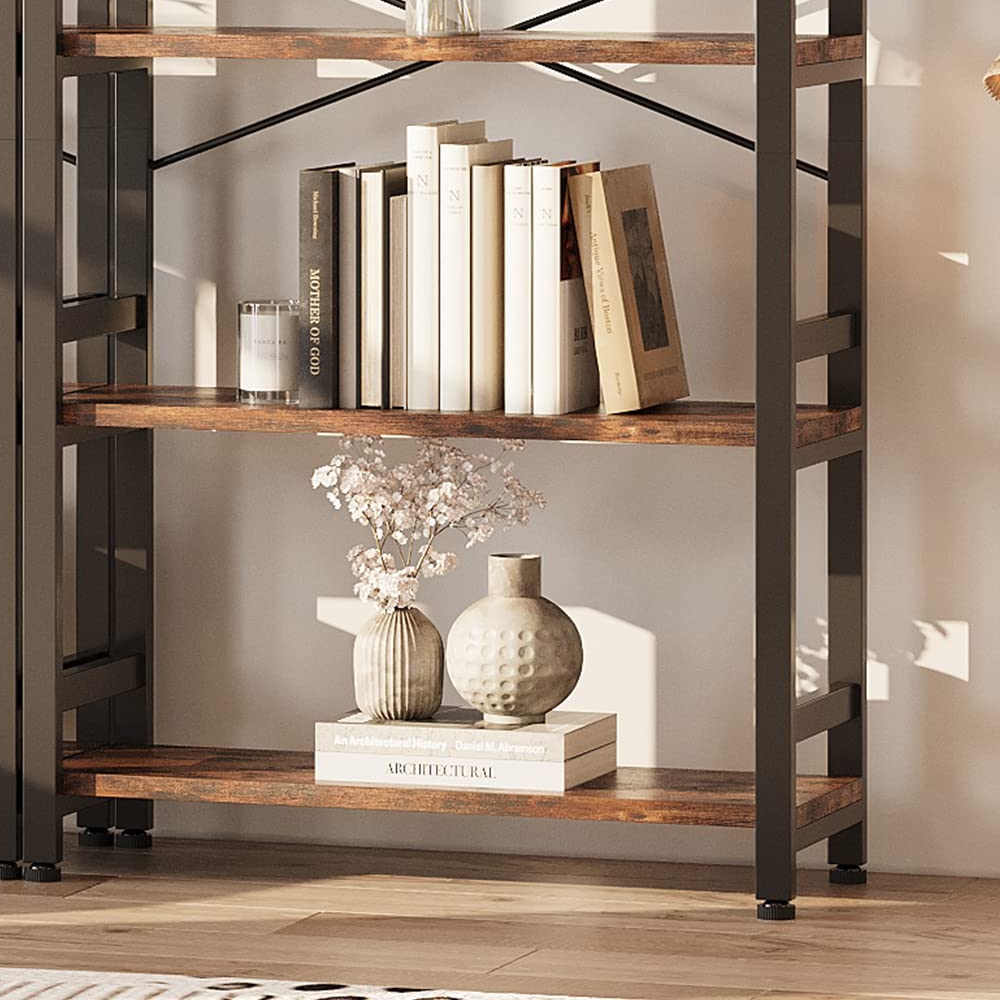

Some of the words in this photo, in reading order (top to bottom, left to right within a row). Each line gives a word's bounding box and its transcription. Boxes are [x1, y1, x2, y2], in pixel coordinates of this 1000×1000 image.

[308, 268, 321, 324] MOTHER
[308, 326, 321, 345] OF
[308, 346, 321, 376] GOD
[334, 735, 348, 745] An
[348, 736, 411, 748] Architectural
[412, 737, 448, 751] History
[455, 740, 484, 751] Daniel
[499, 742, 545, 754] Abramson
[385, 762, 497, 780] ARCHITECTURAL
